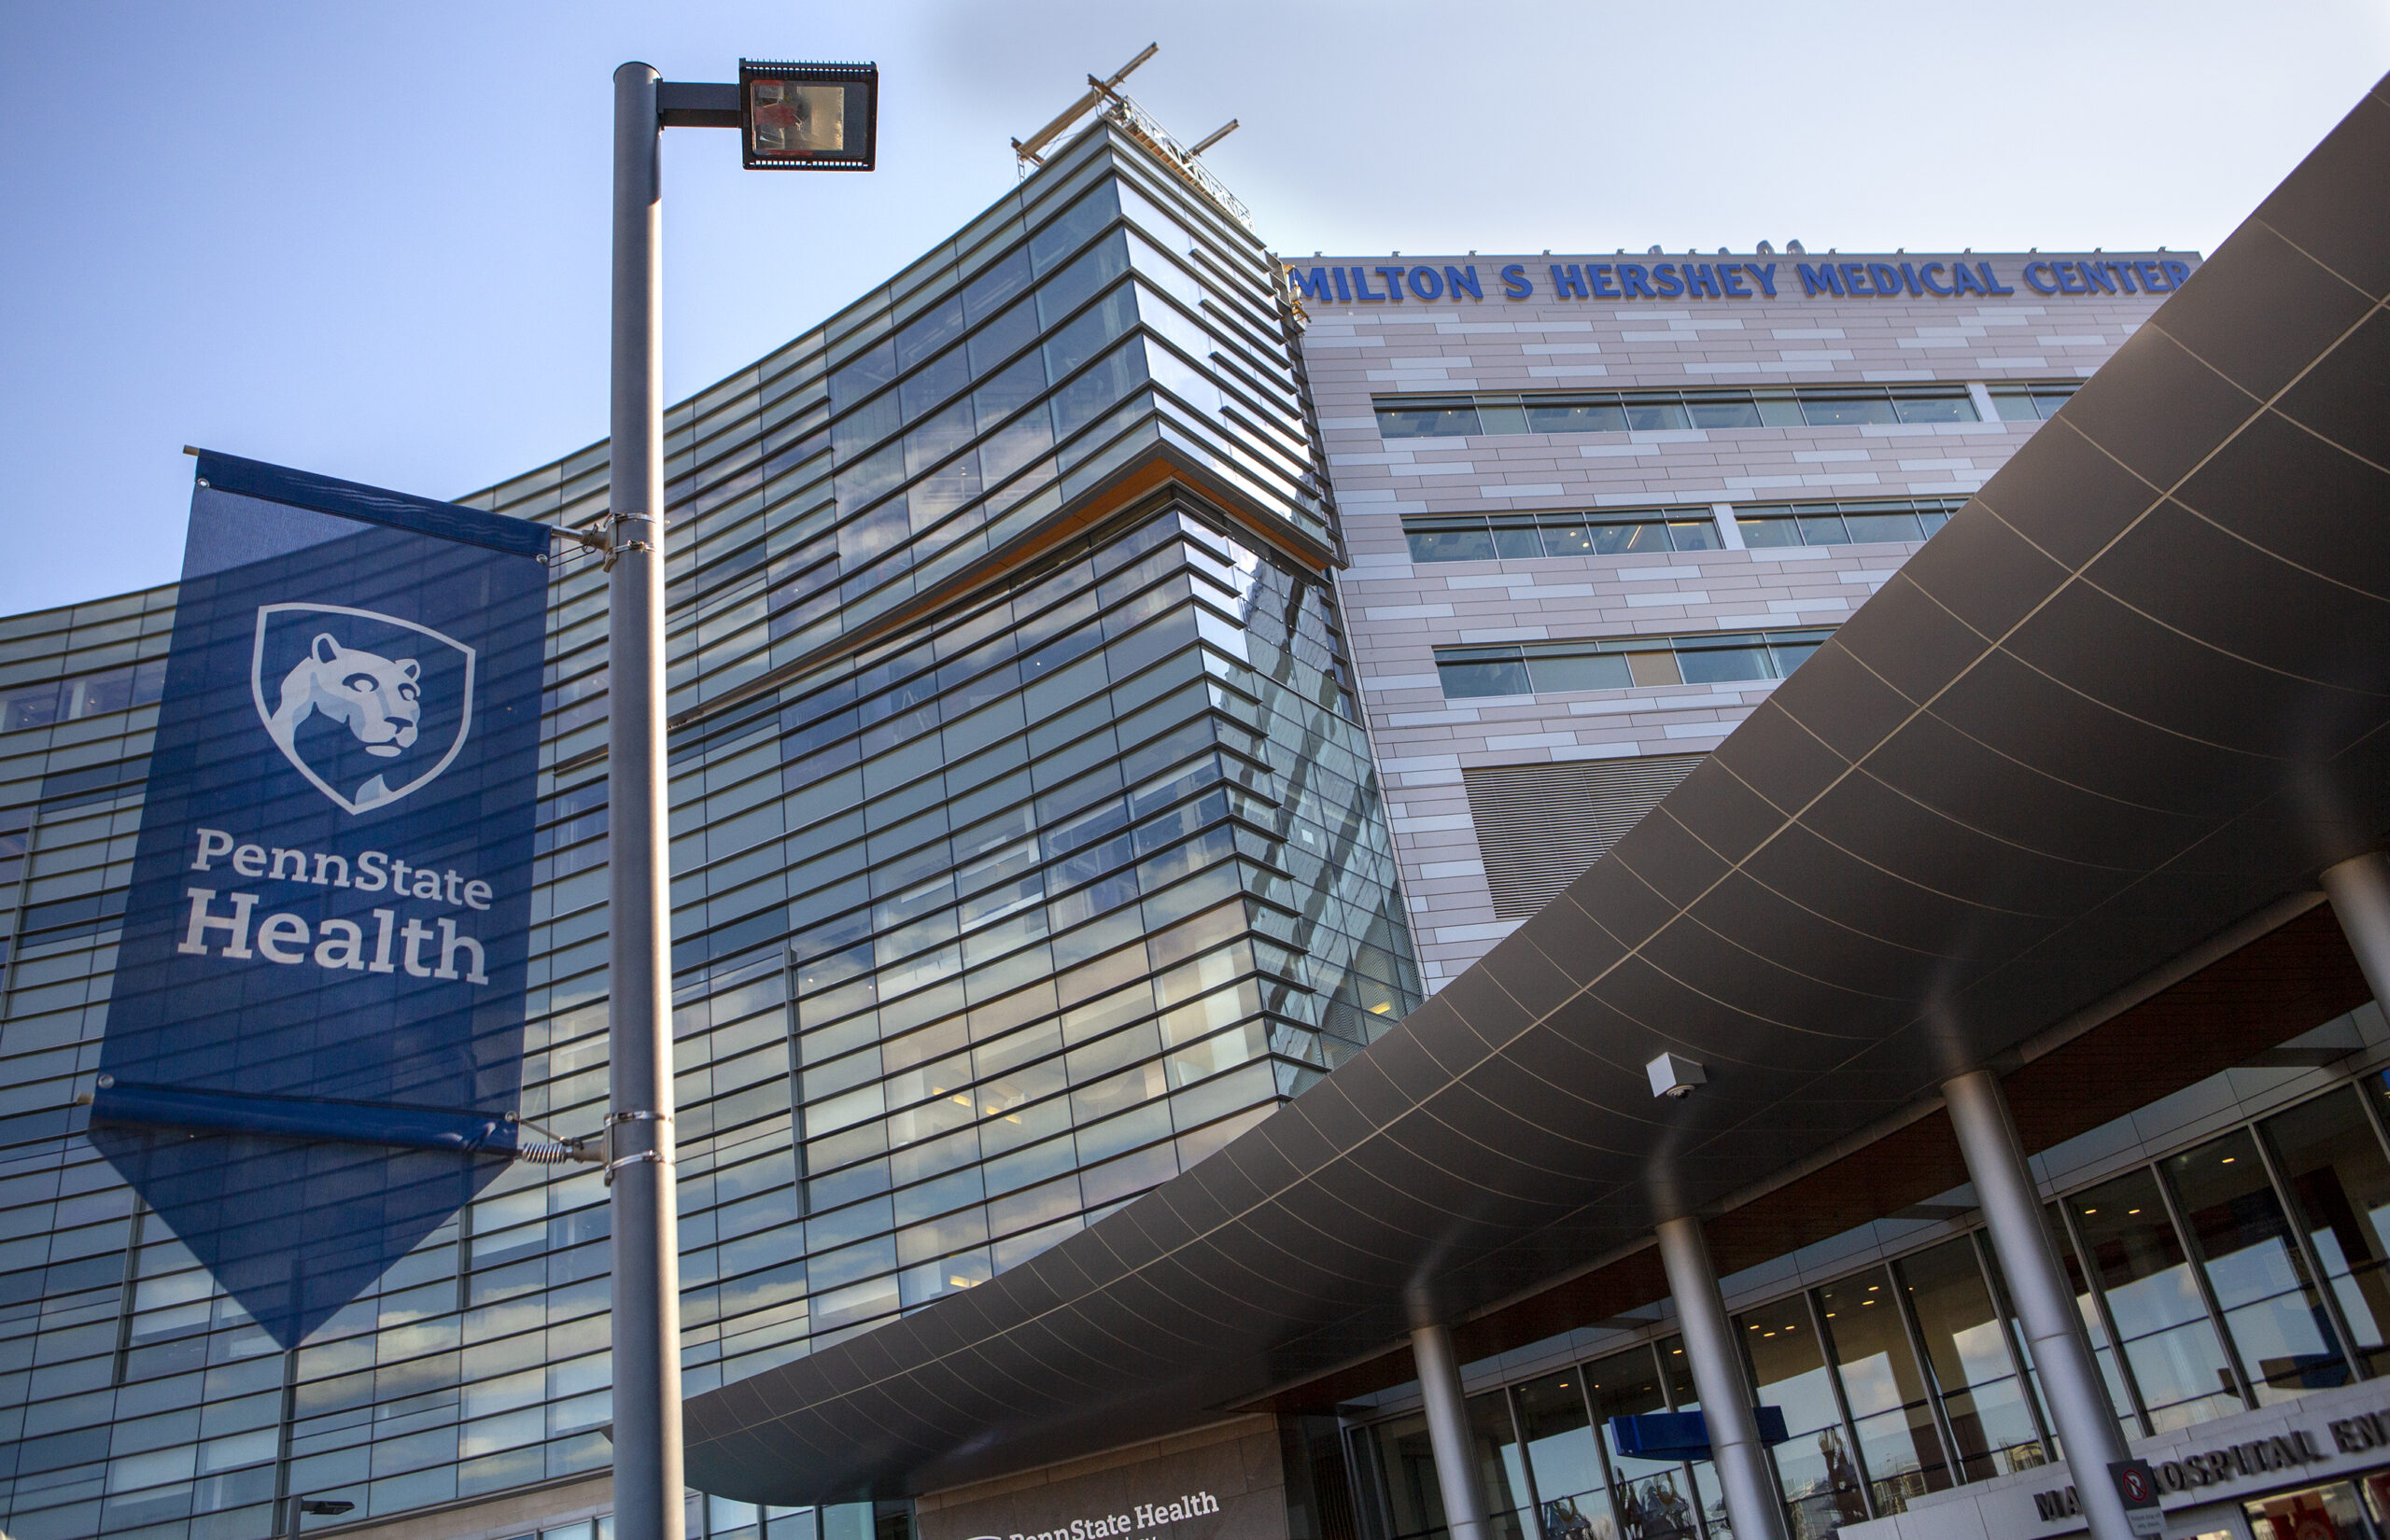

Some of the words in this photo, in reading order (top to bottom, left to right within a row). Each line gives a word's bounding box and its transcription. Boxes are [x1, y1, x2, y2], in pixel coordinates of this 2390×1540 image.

[1288, 265, 1483, 301] MILTON
[1501, 264, 1534, 299] S
[1549, 262, 1778, 299] HERSHEY
[1795, 261, 2015, 297] MEDICAL
[2022, 260, 2190, 295] CENTER
[190, 828, 493, 911] PennState
[177, 888, 489, 986] Health
[2151, 1430, 2325, 1495] OSPITAL
[1134, 1491, 1219, 1529] Health
